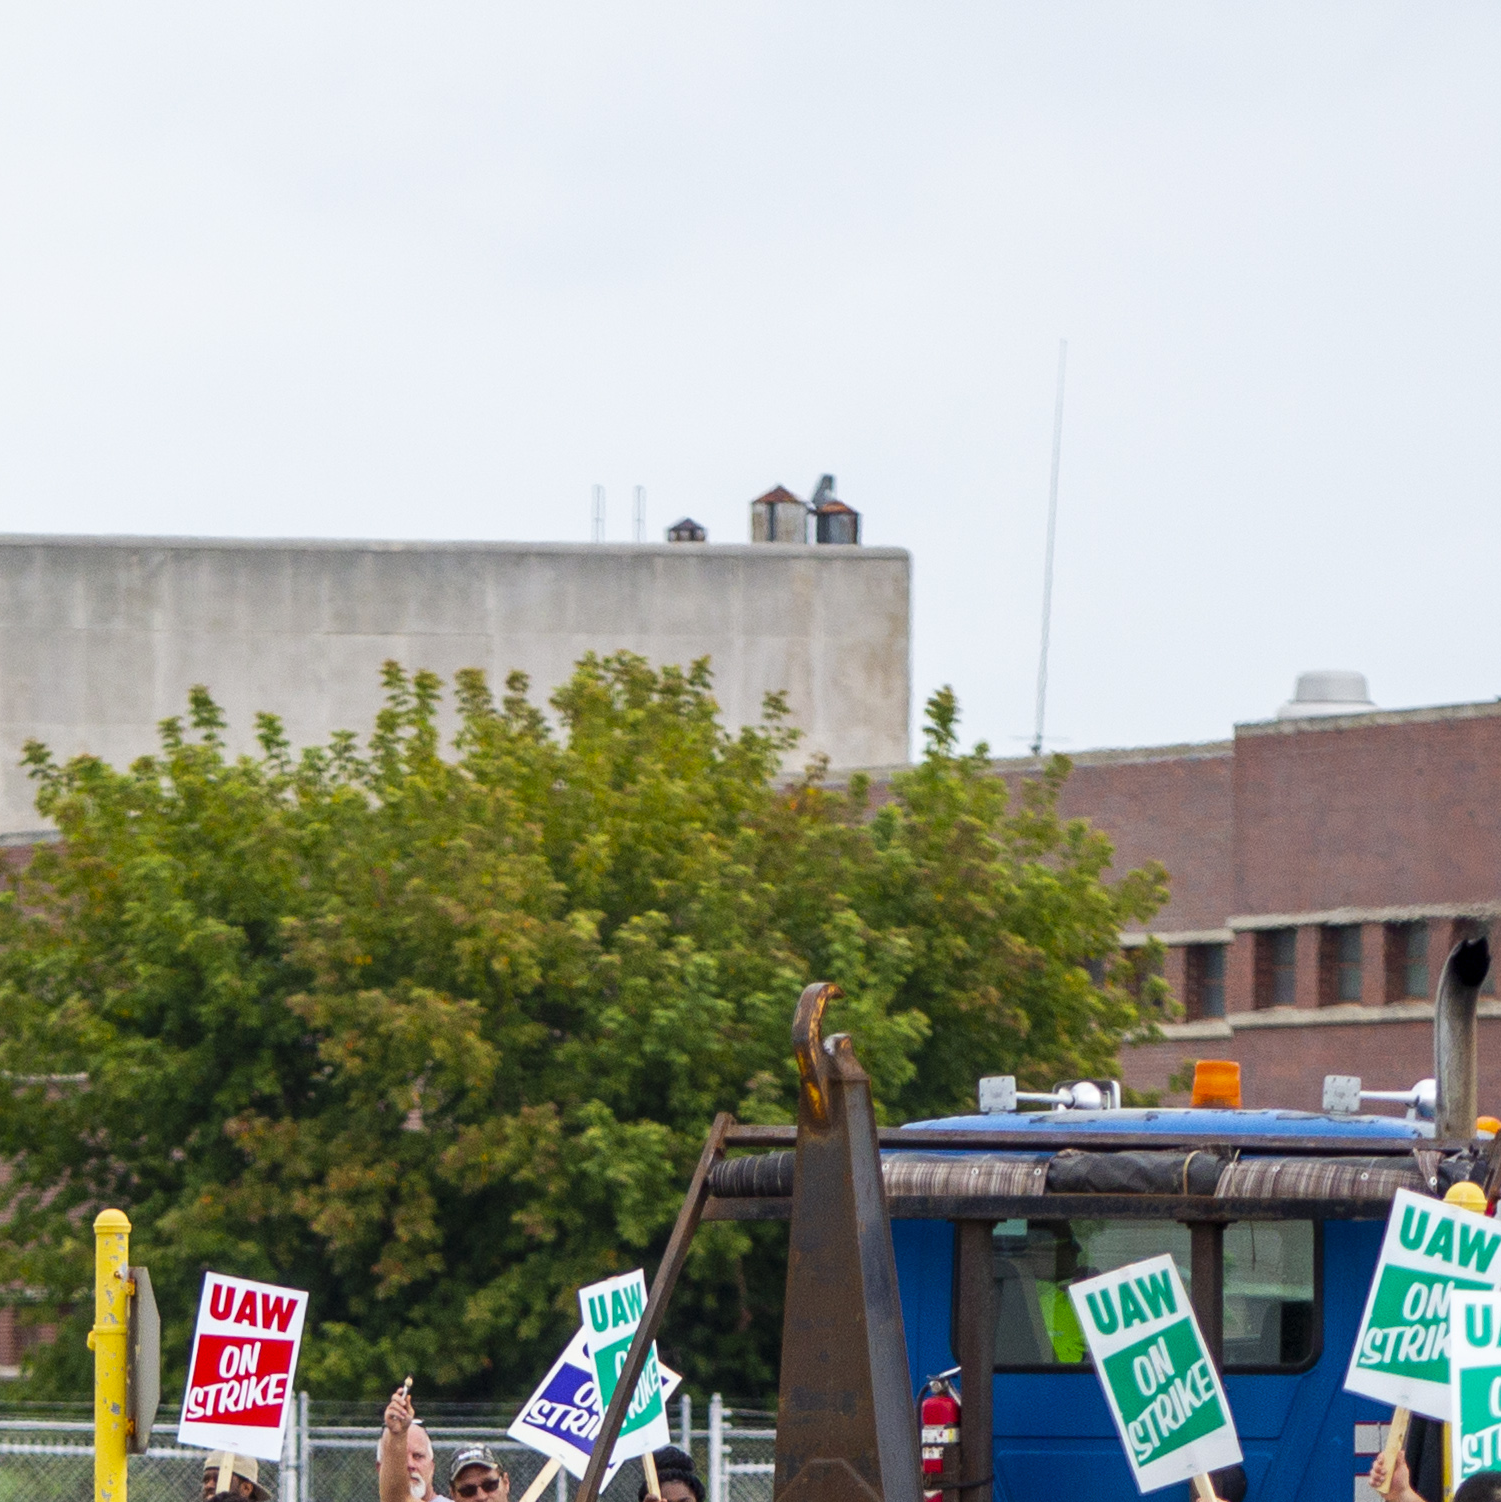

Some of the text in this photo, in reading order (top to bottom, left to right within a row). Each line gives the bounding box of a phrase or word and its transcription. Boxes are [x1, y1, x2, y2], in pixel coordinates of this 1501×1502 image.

[209, 1282, 300, 1334] UAW
[588, 1281, 644, 1333] UAW
[1085, 1268, 1178, 1336] UAW
[1402, 1280, 1456, 1322] ON
[218, 1340, 262, 1379] ON
[1133, 1335, 1176, 1397] ON
[1359, 1323, 1451, 1365] STRIK
[186, 1373, 289, 1420] STRIKE
[525, 1398, 602, 1441] STRI
[1127, 1357, 1216, 1462] STRIKE
